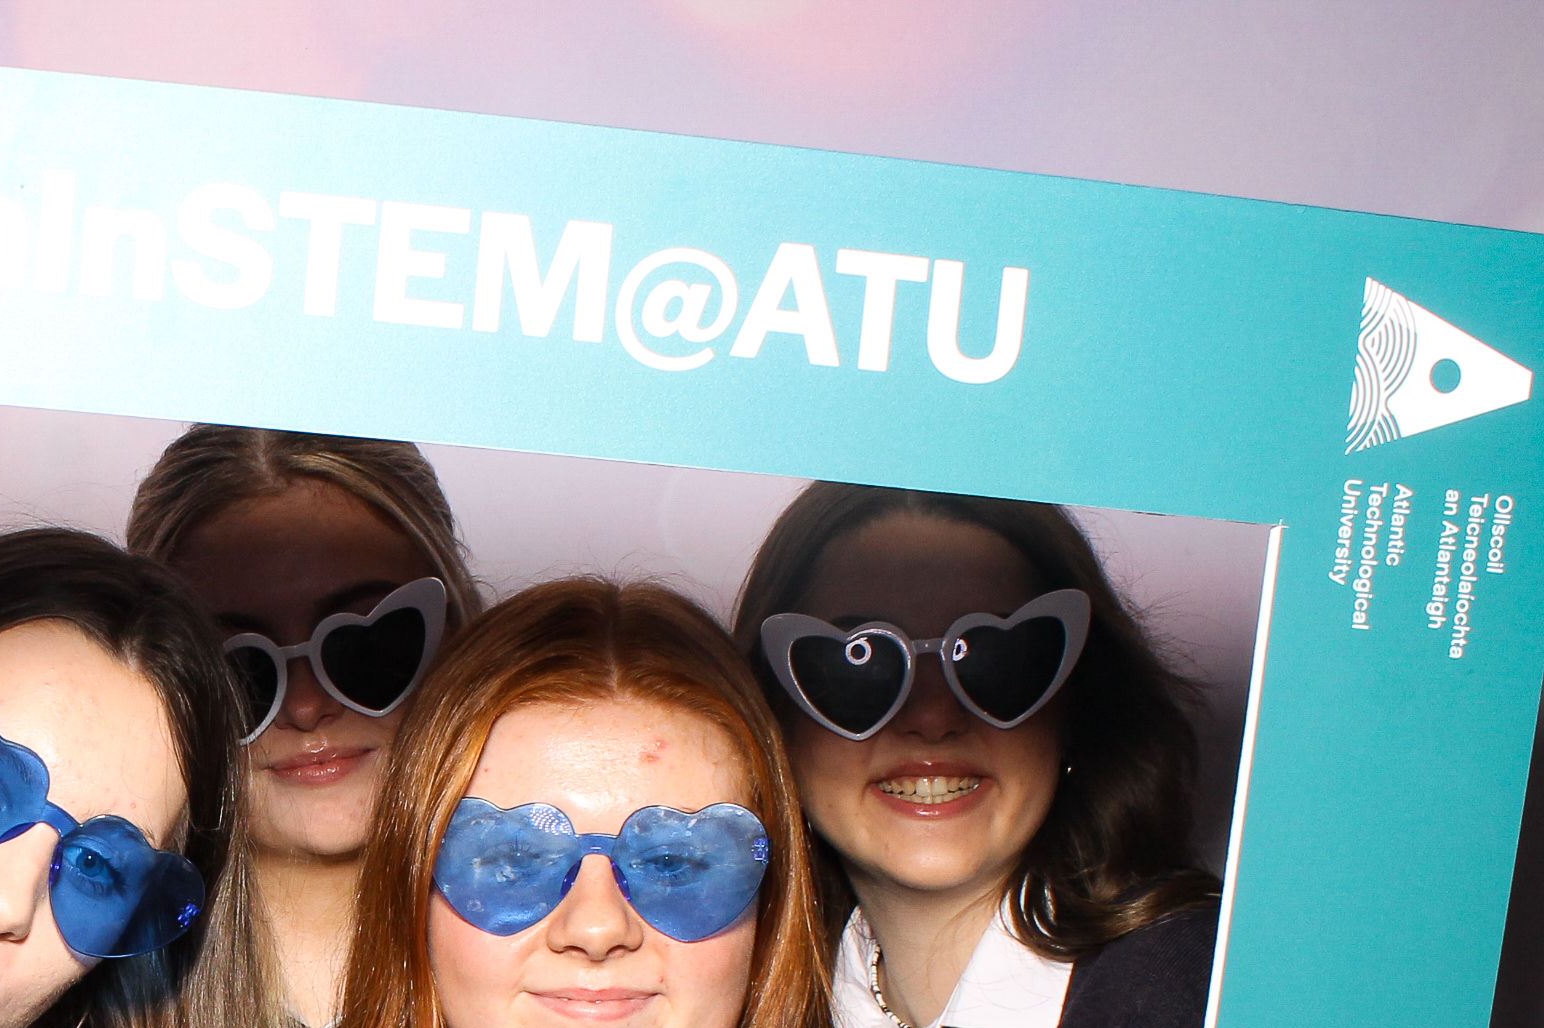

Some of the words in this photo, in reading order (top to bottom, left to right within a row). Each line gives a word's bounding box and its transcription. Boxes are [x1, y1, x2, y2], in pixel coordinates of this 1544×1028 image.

[1328, 477, 1365, 587] University
[1351, 481, 1391, 631] Technological
[1385, 482, 1415, 568] Atlantic
[1442, 488, 1461, 517] an
[1485, 493, 1514, 575] Ollscoil
[1425, 519, 1461, 630] Atlantaigh
[1448, 492, 1490, 660] Teicneolaíochta
